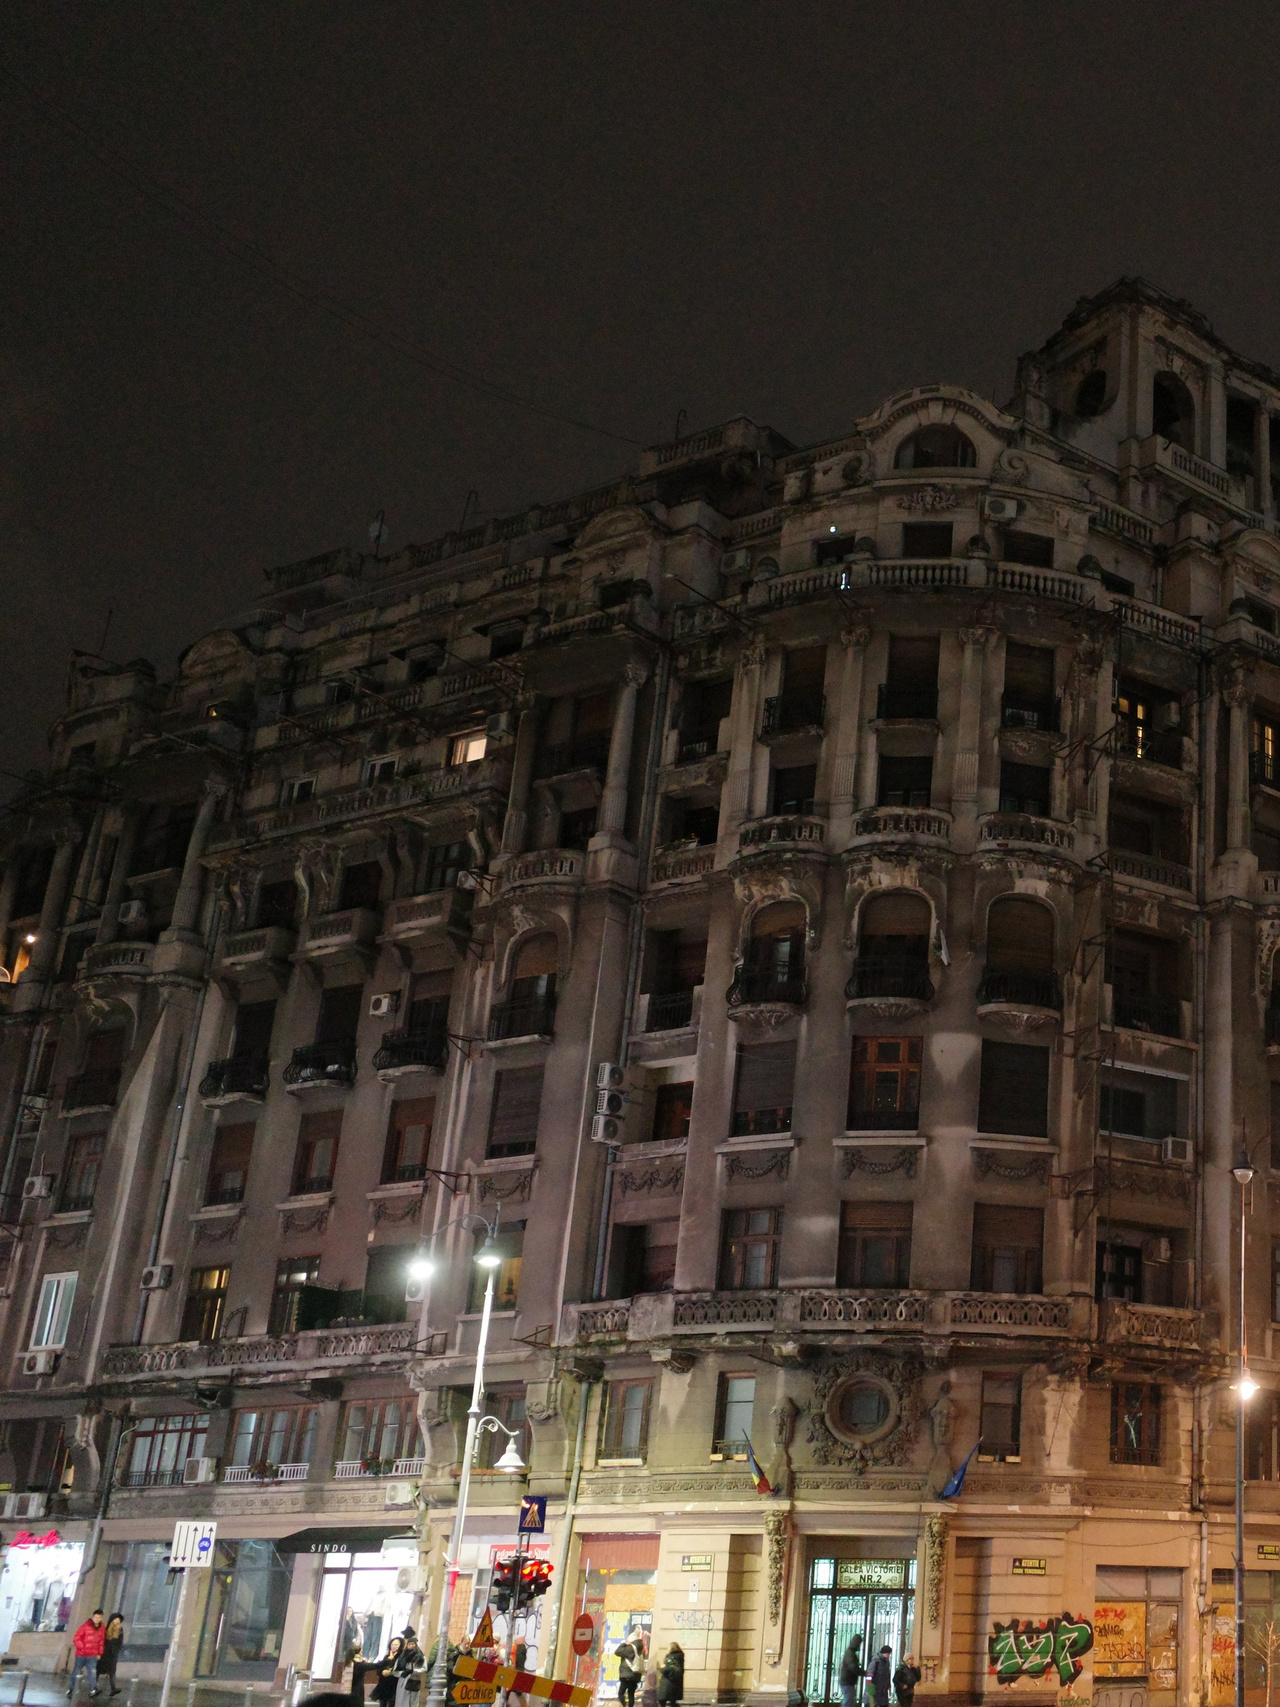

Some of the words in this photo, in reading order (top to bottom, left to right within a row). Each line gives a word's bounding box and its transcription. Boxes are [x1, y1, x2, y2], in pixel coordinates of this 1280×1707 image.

[310, 1543, 347, 1553] SINDO
[839, 1565, 863, 1574] CALEA
[866, 1565, 904, 1574] VICTORIEI
[859, 1574, 883, 1584] NR.2
[460, 1684, 494, 1701] Ocolire
